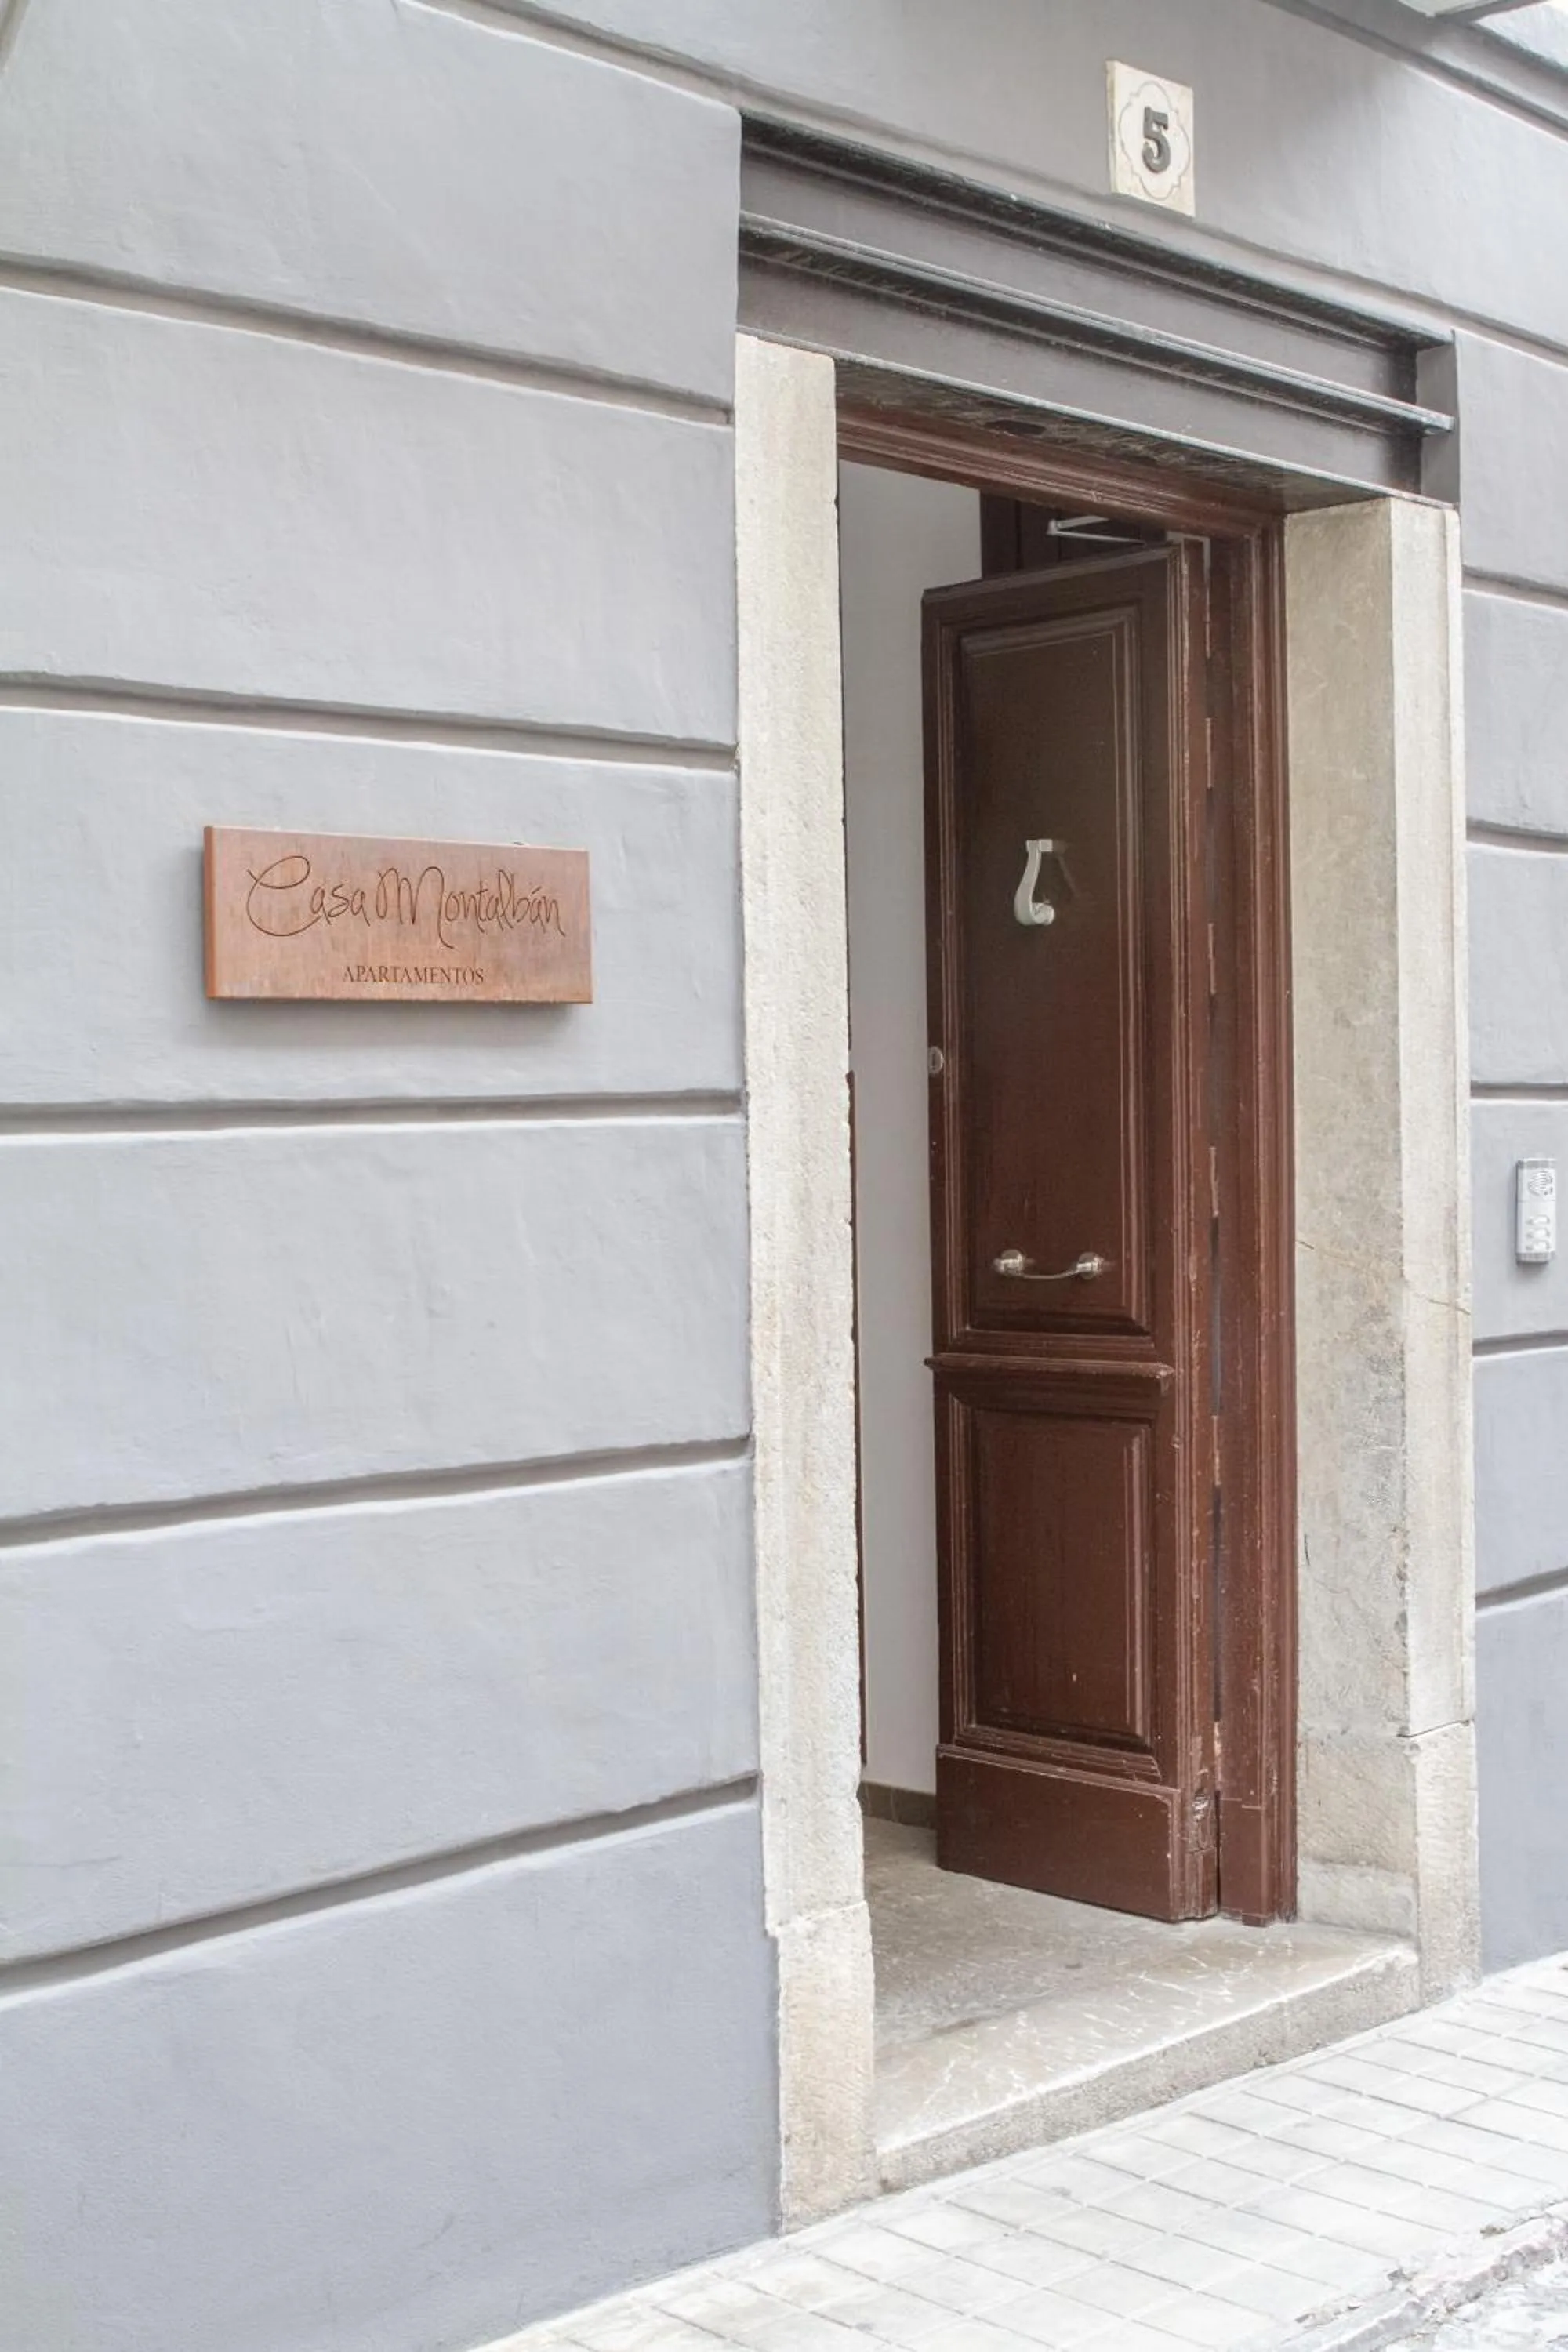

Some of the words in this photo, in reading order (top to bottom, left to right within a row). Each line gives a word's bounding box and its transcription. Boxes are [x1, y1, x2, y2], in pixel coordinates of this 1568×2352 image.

[1142, 107, 1171, 173] 5
[247, 855, 371, 936] Casa
[376, 866, 565, 949] Montalbán
[343, 965, 485, 984] APARTAMENTOS
